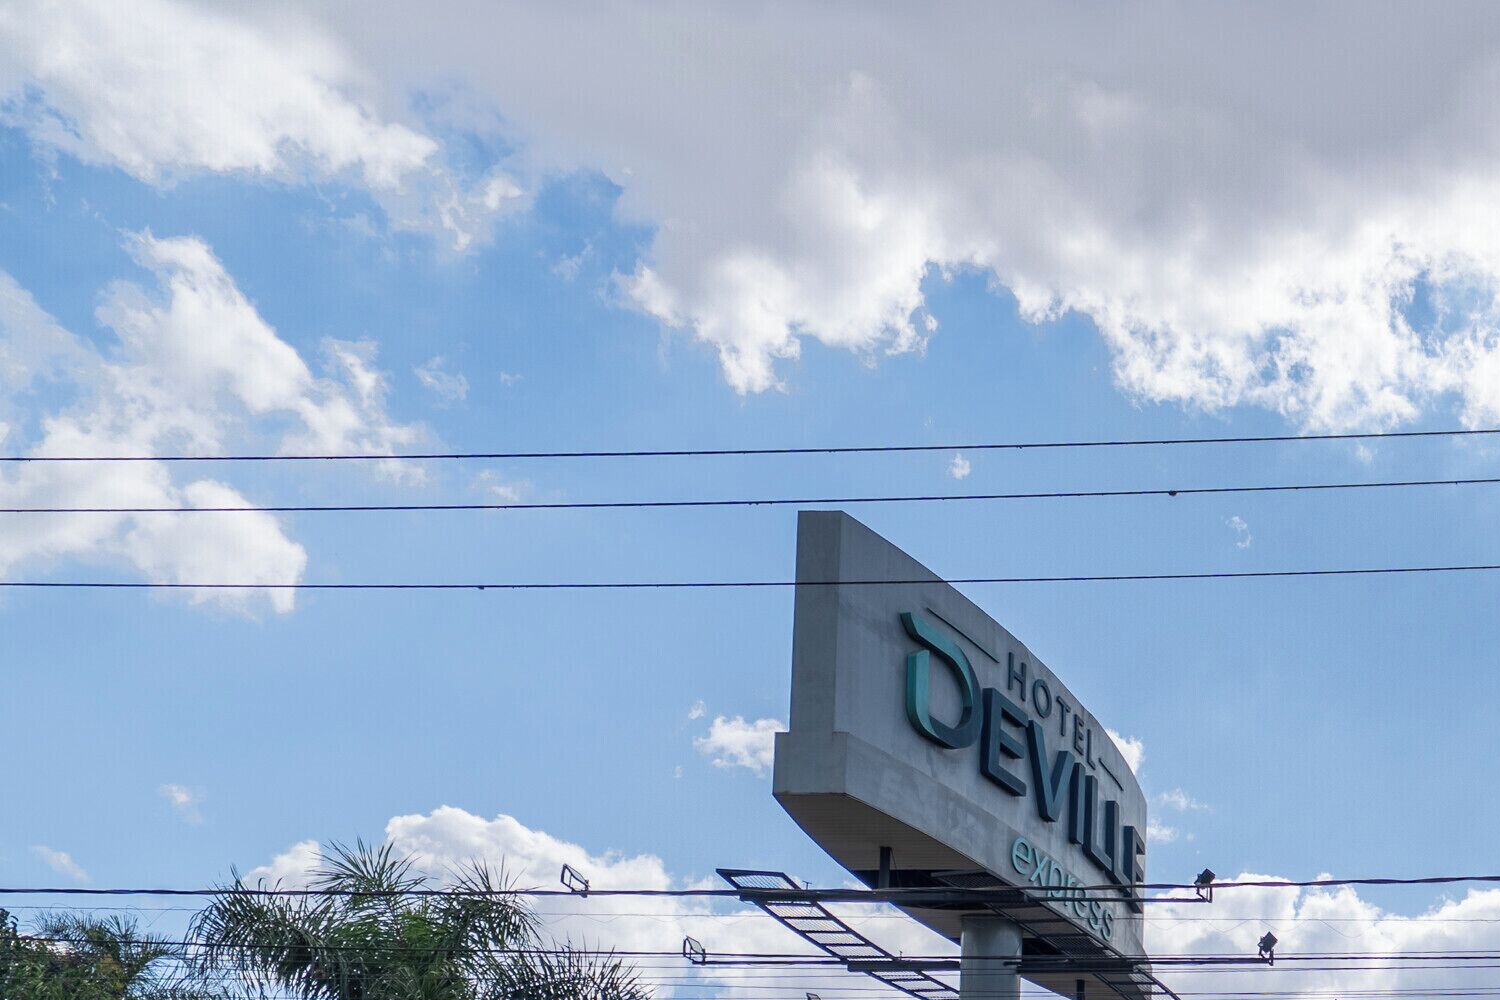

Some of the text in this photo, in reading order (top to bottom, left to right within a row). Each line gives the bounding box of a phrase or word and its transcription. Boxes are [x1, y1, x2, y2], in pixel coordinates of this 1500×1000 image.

[900, 612, 1146, 914] DEVILLE
[1007, 651, 1096, 770] HOTEL
[1011, 836, 1114, 942] express
